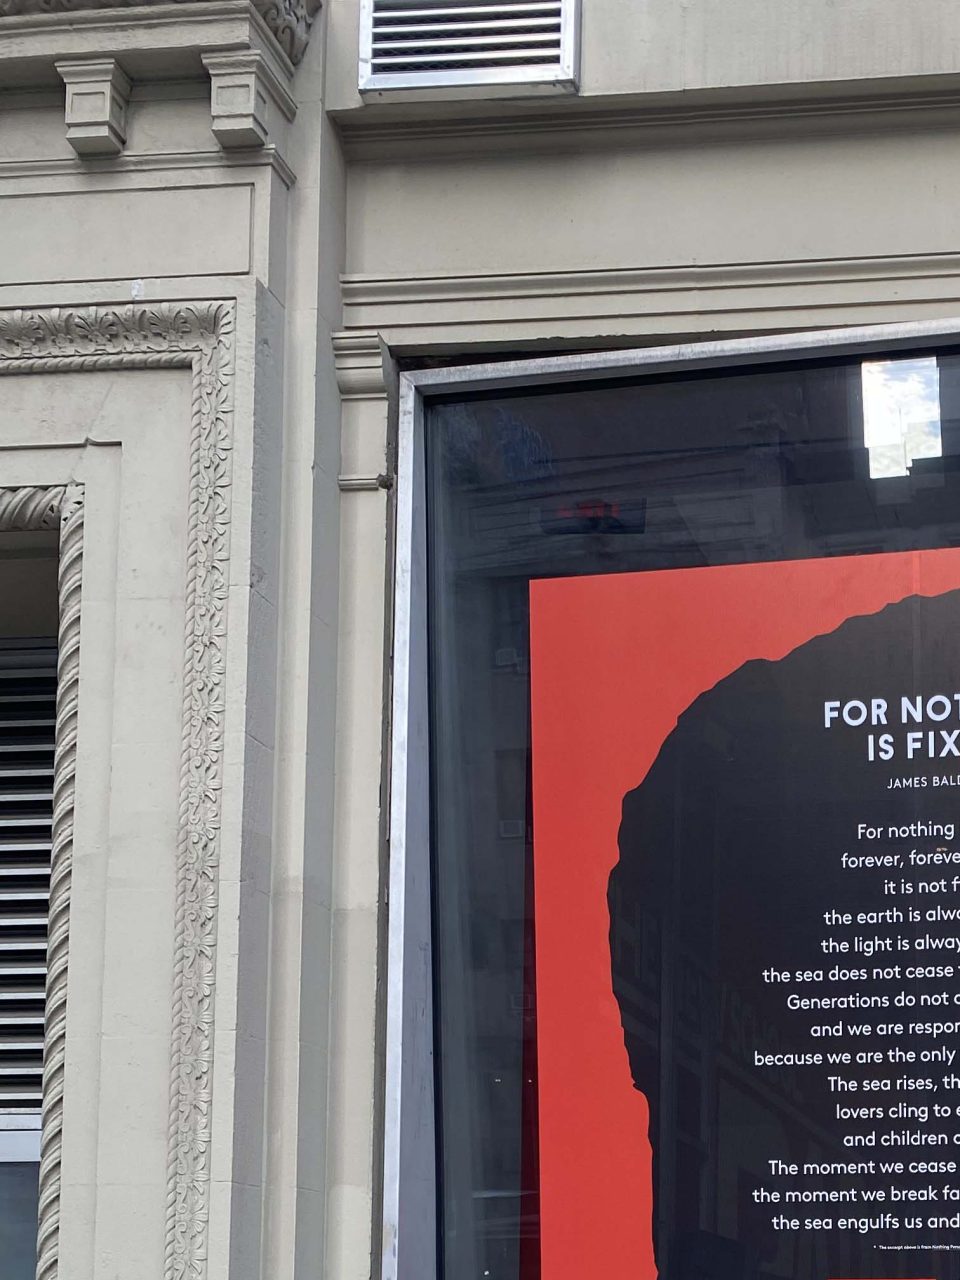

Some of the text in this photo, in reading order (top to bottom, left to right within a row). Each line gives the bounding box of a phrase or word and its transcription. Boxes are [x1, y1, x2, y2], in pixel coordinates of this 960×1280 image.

[825, 699, 887, 728] FOR
[868, 734, 894, 761] IS
[887, 777, 927, 789] JAMES
[858, 824, 883, 839] For
[889, 821, 954, 840] nothing
[841, 853, 903, 868] forever,
[885, 880, 896, 894] it
[901, 879, 913, 893] is
[919, 879, 947, 893] not
[824, 910, 852, 925] the
[857, 907, 903, 923] earth
[909, 907, 920, 921] is
[821, 938, 849, 953] the
[855, 936, 892, 956] light
[898, 936, 909, 950] is
[762, 968, 790, 982] the
[796, 971, 823, 981] sea
[829, 966, 867, 980] does
[873, 966, 901, 979] not
[906, 966, 953, 978] cease
[787, 993, 889, 1009] Generations
[894, 991, 915, 1006] do
[921, 992, 949, 1005] not
[811, 1021, 842, 1036] and
[848, 1025, 871, 1035] we
[877, 1024, 903, 1035] are
[755, 1051, 822, 1065] because
[827, 1053, 851, 1063] we
[856, 1052, 883, 1063] are
[887, 1047, 915, 1062] the
[921, 1046, 956, 1065] only
[828, 1077, 857, 1091] The
[863, 1080, 890, 1090] sea
[897, 1075, 937, 1092] rises,
[837, 1104, 883, 1119] lovers
[889, 1103, 928, 1122] cling
[933, 1104, 951, 1117] to
[844, 1131, 875, 1146] and
[881, 1130, 947, 1146] children
[768, 1160, 798, 1175] The
[804, 1161, 875, 1174] moment
[880, 1163, 904, 1173] we
[909, 1162, 956, 1173] cease
[752, 1188, 780, 1202] the
[786, 1189, 857, 1202] moment
[861, 1191, 885, 1201] we
[891, 1186, 938, 1201] break
[772, 1215, 799, 1229] the
[805, 1219, 832, 1229] sea
[838, 1214, 899, 1233] engulfs
[905, 1218, 922, 1228] us
[928, 1213, 959, 1228] and
